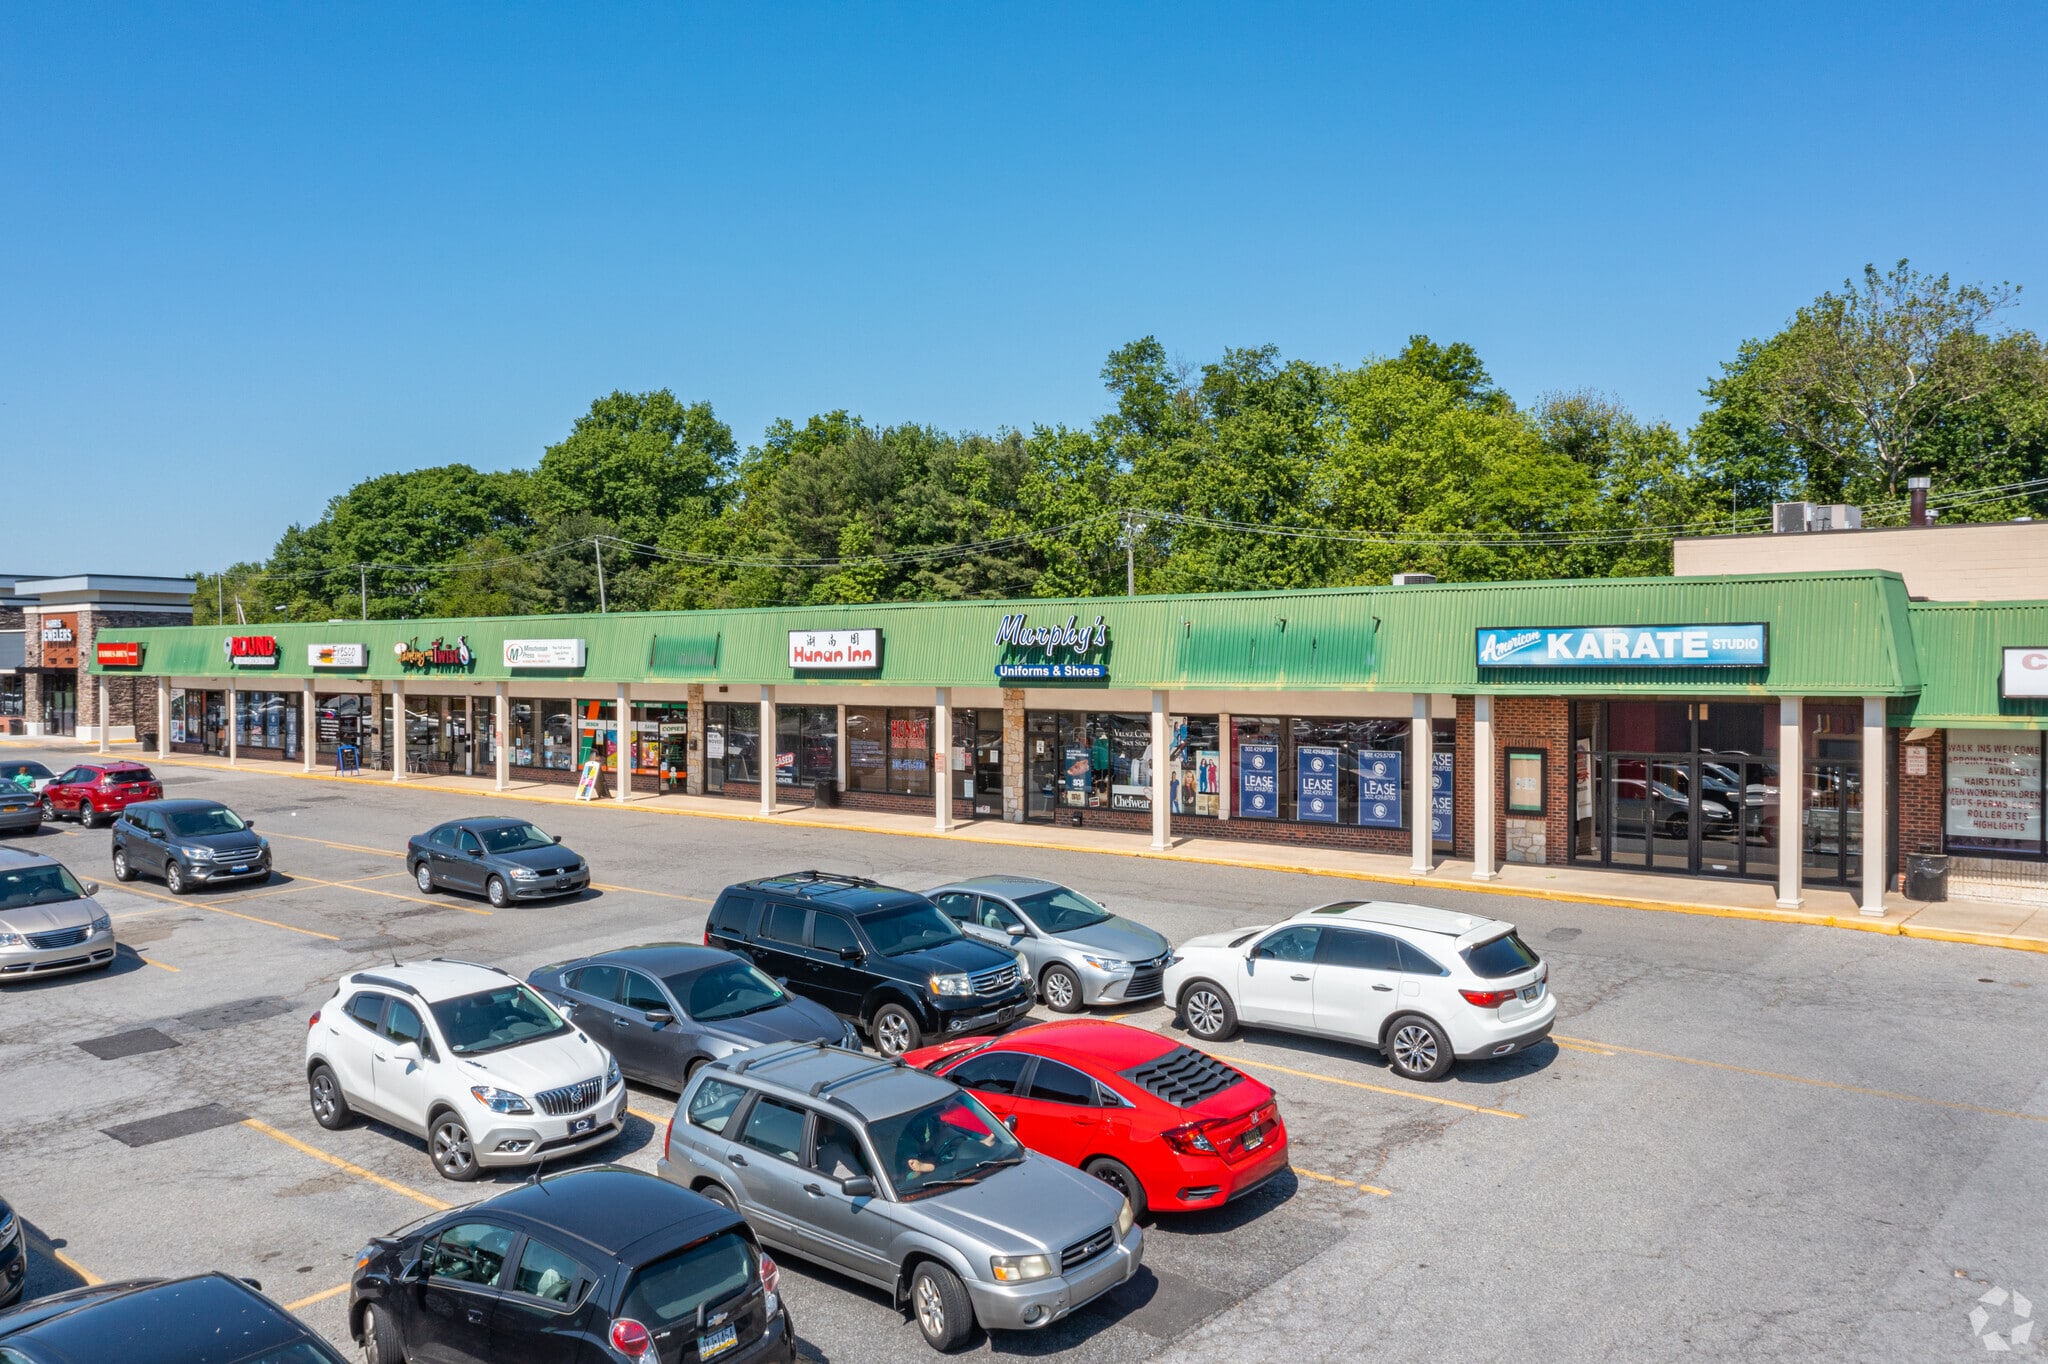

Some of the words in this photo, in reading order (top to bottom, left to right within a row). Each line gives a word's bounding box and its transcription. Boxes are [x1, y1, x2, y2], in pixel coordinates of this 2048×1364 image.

[995, 614, 1106, 656] Murphy's
[1480, 631, 1541, 662] American
[1546, 631, 1709, 659] KARATE
[1712, 638, 1759, 650] STUDIO
[793, 646, 844, 663] Hunan
[847, 645, 873, 662] Inn
[1000, 665, 1049, 676] Uniforms
[1052, 665, 1061, 676] &
[1064, 665, 1101, 676] Shoes
[1947, 744, 1973, 752] WALK
[1977, 744, 1991, 753] INS
[1994, 745, 2040, 755] WELCOME
[1987, 767, 2038, 777] AVAILABLE
[1244, 775, 1273, 788] LEASE
[1303, 778, 1333, 791] LEASE
[1963, 778, 2022, 787] HAIRSTYLIST
[1364, 783, 1396, 796] LEASE
[1114, 794, 1151, 809] Chefwear
[1967, 809, 2002, 819] ROLLER
[2005, 811, 2029, 821] SETS
[1973, 820, 2025, 831] HIGHLIGHTS
